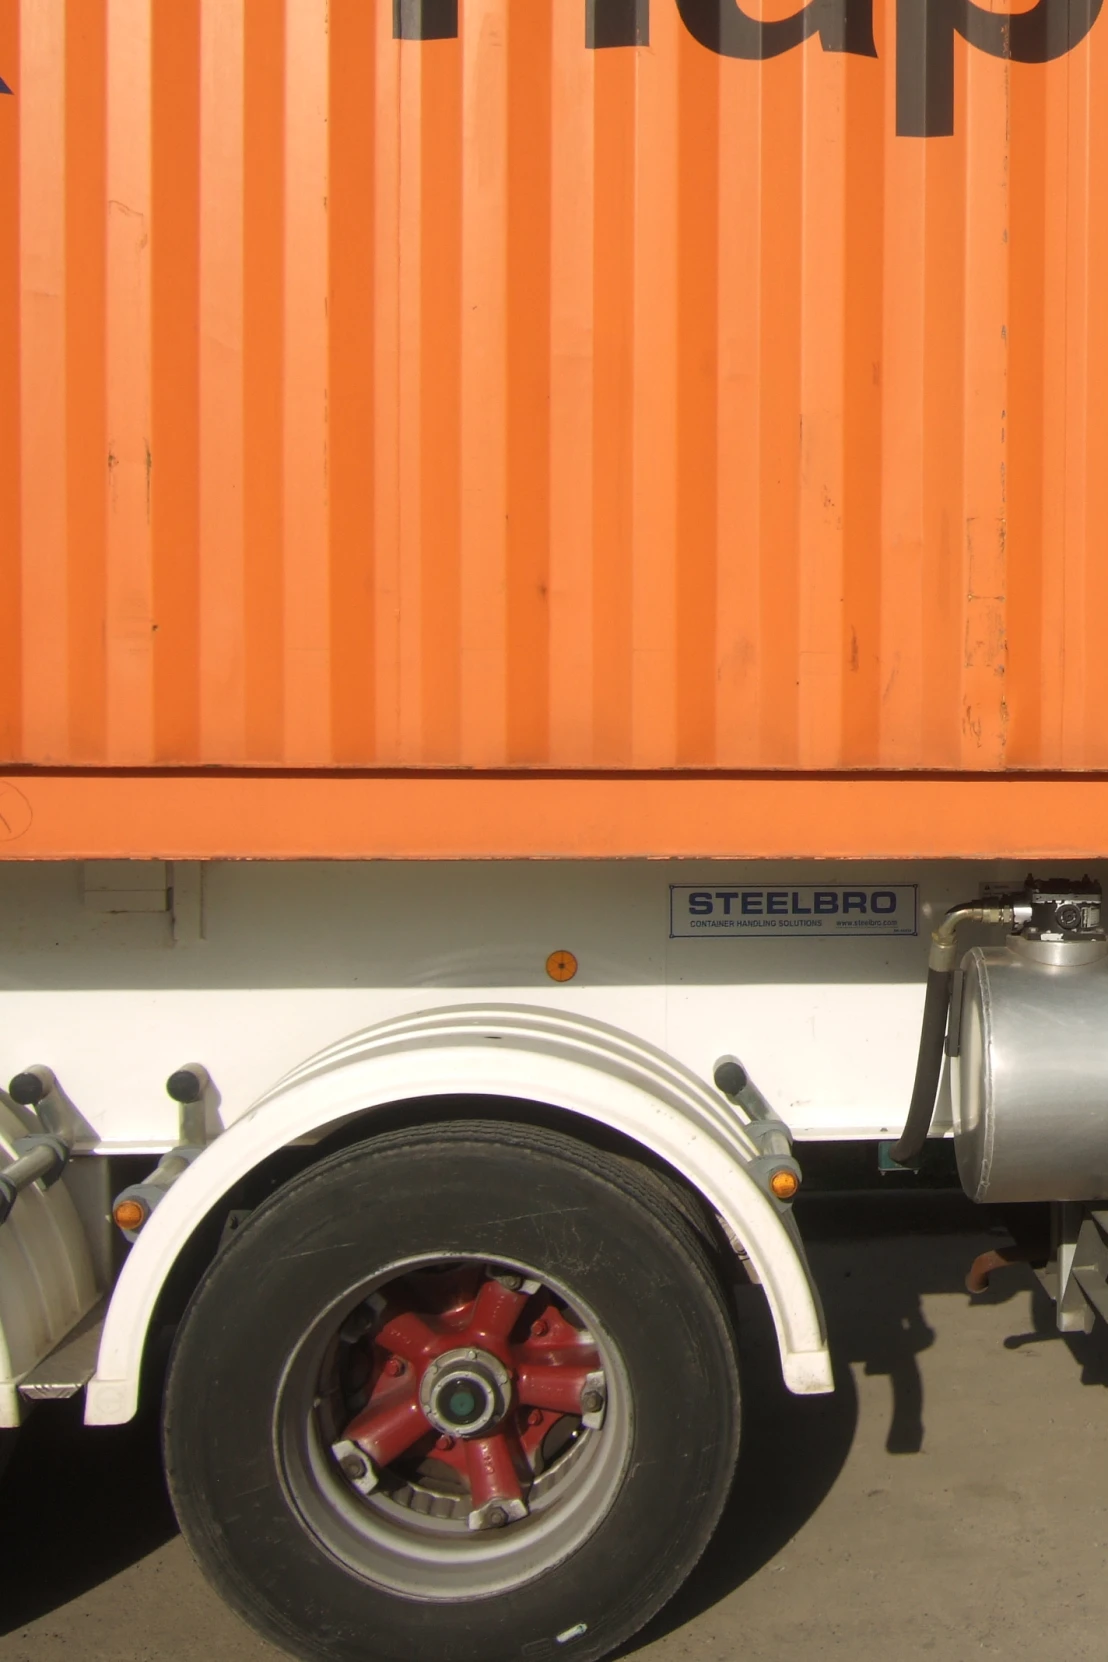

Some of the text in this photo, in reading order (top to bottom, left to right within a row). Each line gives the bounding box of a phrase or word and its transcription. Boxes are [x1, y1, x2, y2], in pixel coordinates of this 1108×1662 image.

[688, 891, 897, 915] STEELBRO
[690, 919, 823, 928] CONTAINER HANDLING SOLUTIONS
[836, 919, 898, 927] www.steelbro.com
